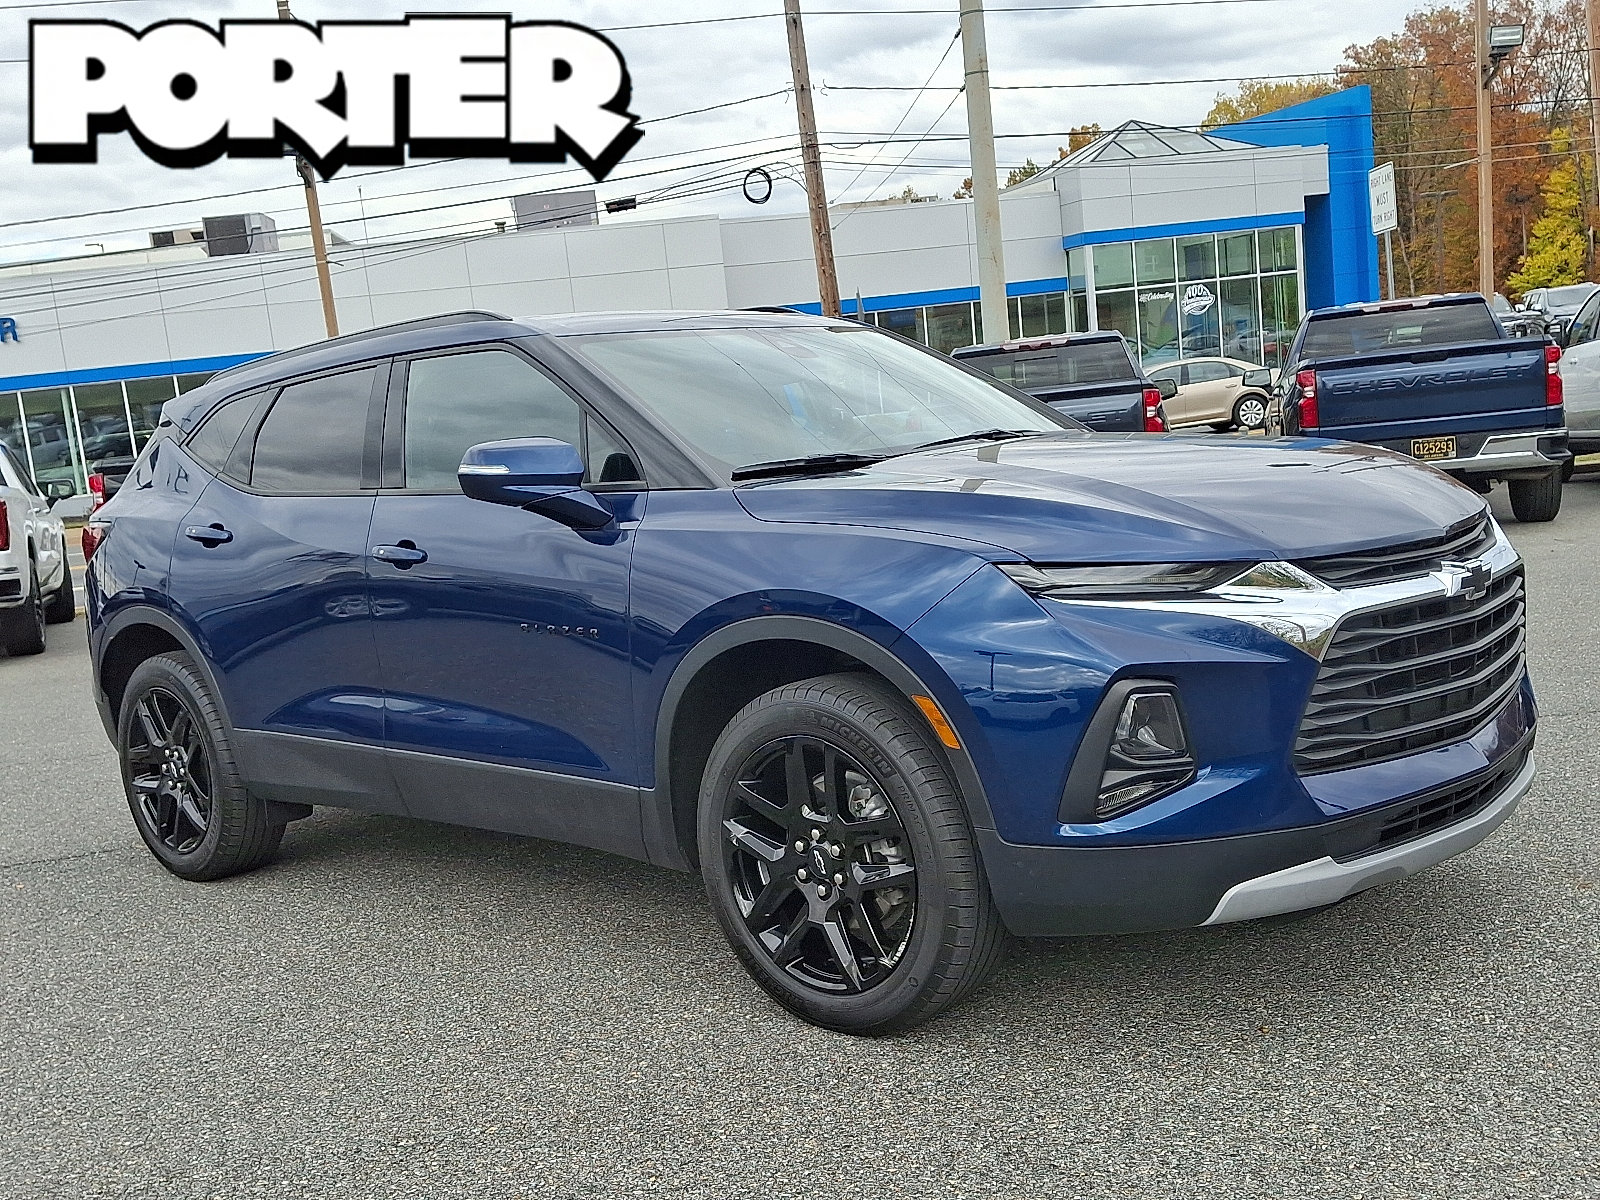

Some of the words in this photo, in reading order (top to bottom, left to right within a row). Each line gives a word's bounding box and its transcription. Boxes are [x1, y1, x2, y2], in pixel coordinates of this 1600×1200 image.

[1382, 172, 1392, 184] LANE
[1376, 191, 1389, 206] MUST
[1373, 213, 1383, 225] TURN
[1384, 209, 1395, 221] RIGHT
[1332, 364, 1532, 395] CHEVROLET
[1414, 440, 1453, 455] C125293
[520, 622, 599, 639] BLAZER
[820, 715, 893, 775] MICHELIN
